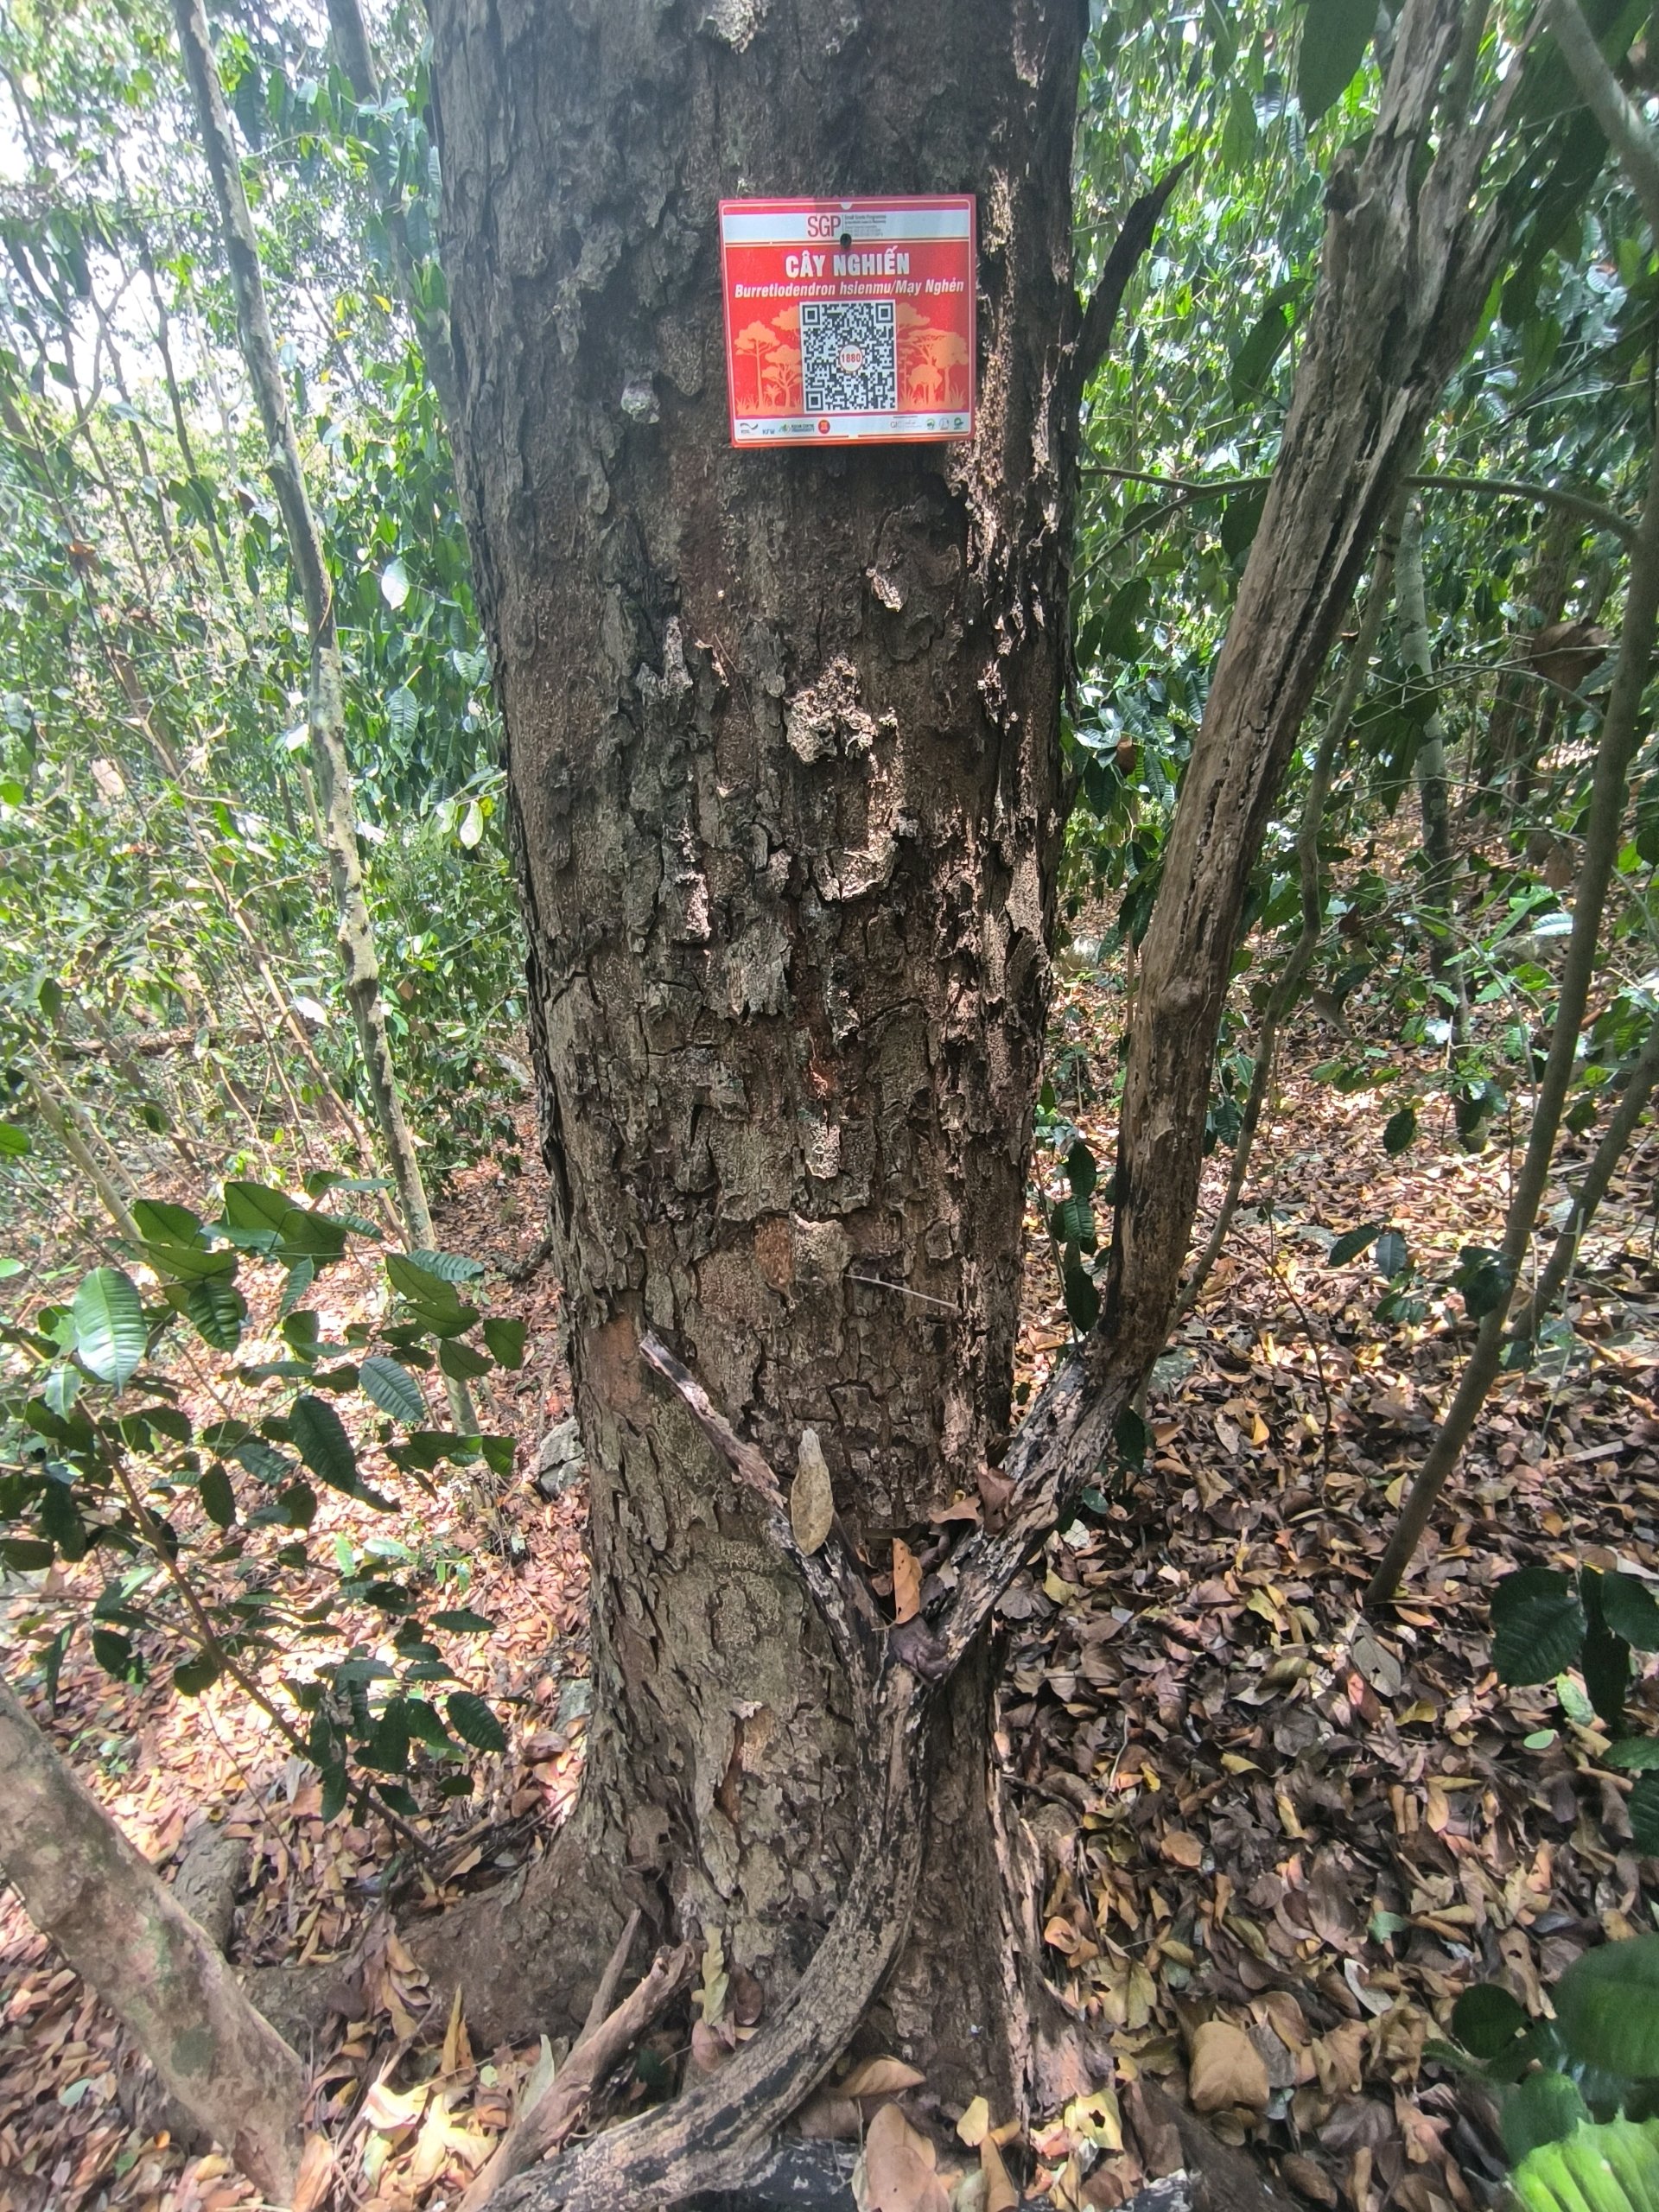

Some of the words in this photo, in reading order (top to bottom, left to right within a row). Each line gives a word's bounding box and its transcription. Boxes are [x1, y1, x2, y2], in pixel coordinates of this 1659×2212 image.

[808, 215, 841, 238] SGP
[785, 250, 825, 278] CÂY
[833, 245, 910, 276] NGHIẾN
[734, 282, 836, 298] Burretiodendron
[842, 353, 861, 363] 1880
